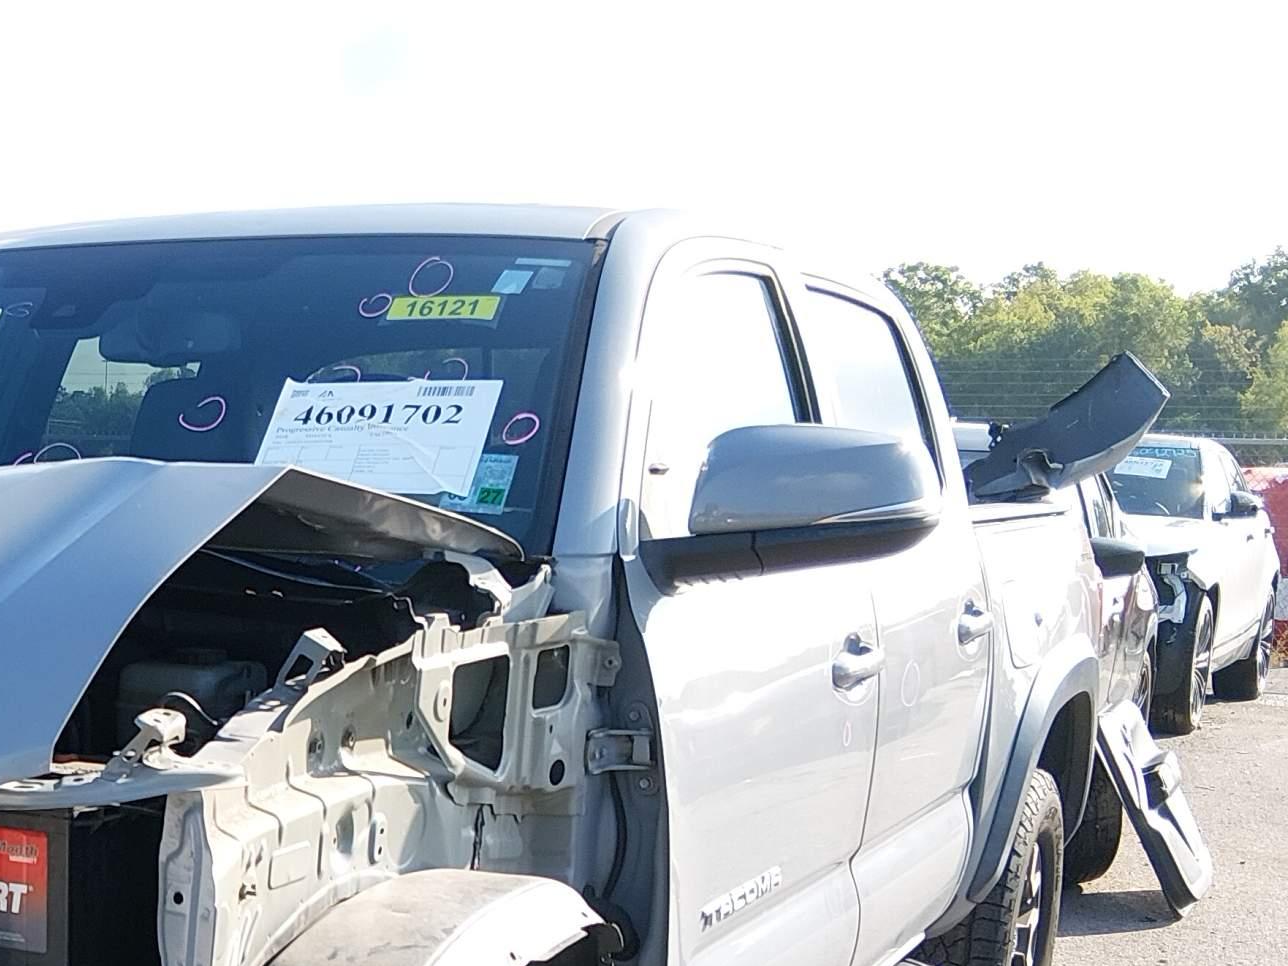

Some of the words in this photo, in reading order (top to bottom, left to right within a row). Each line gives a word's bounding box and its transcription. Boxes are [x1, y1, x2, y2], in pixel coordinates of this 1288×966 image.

[406, 299, 480, 317] 16121
[293, 403, 463, 425] 46091702
[480, 489, 502, 504] 27
